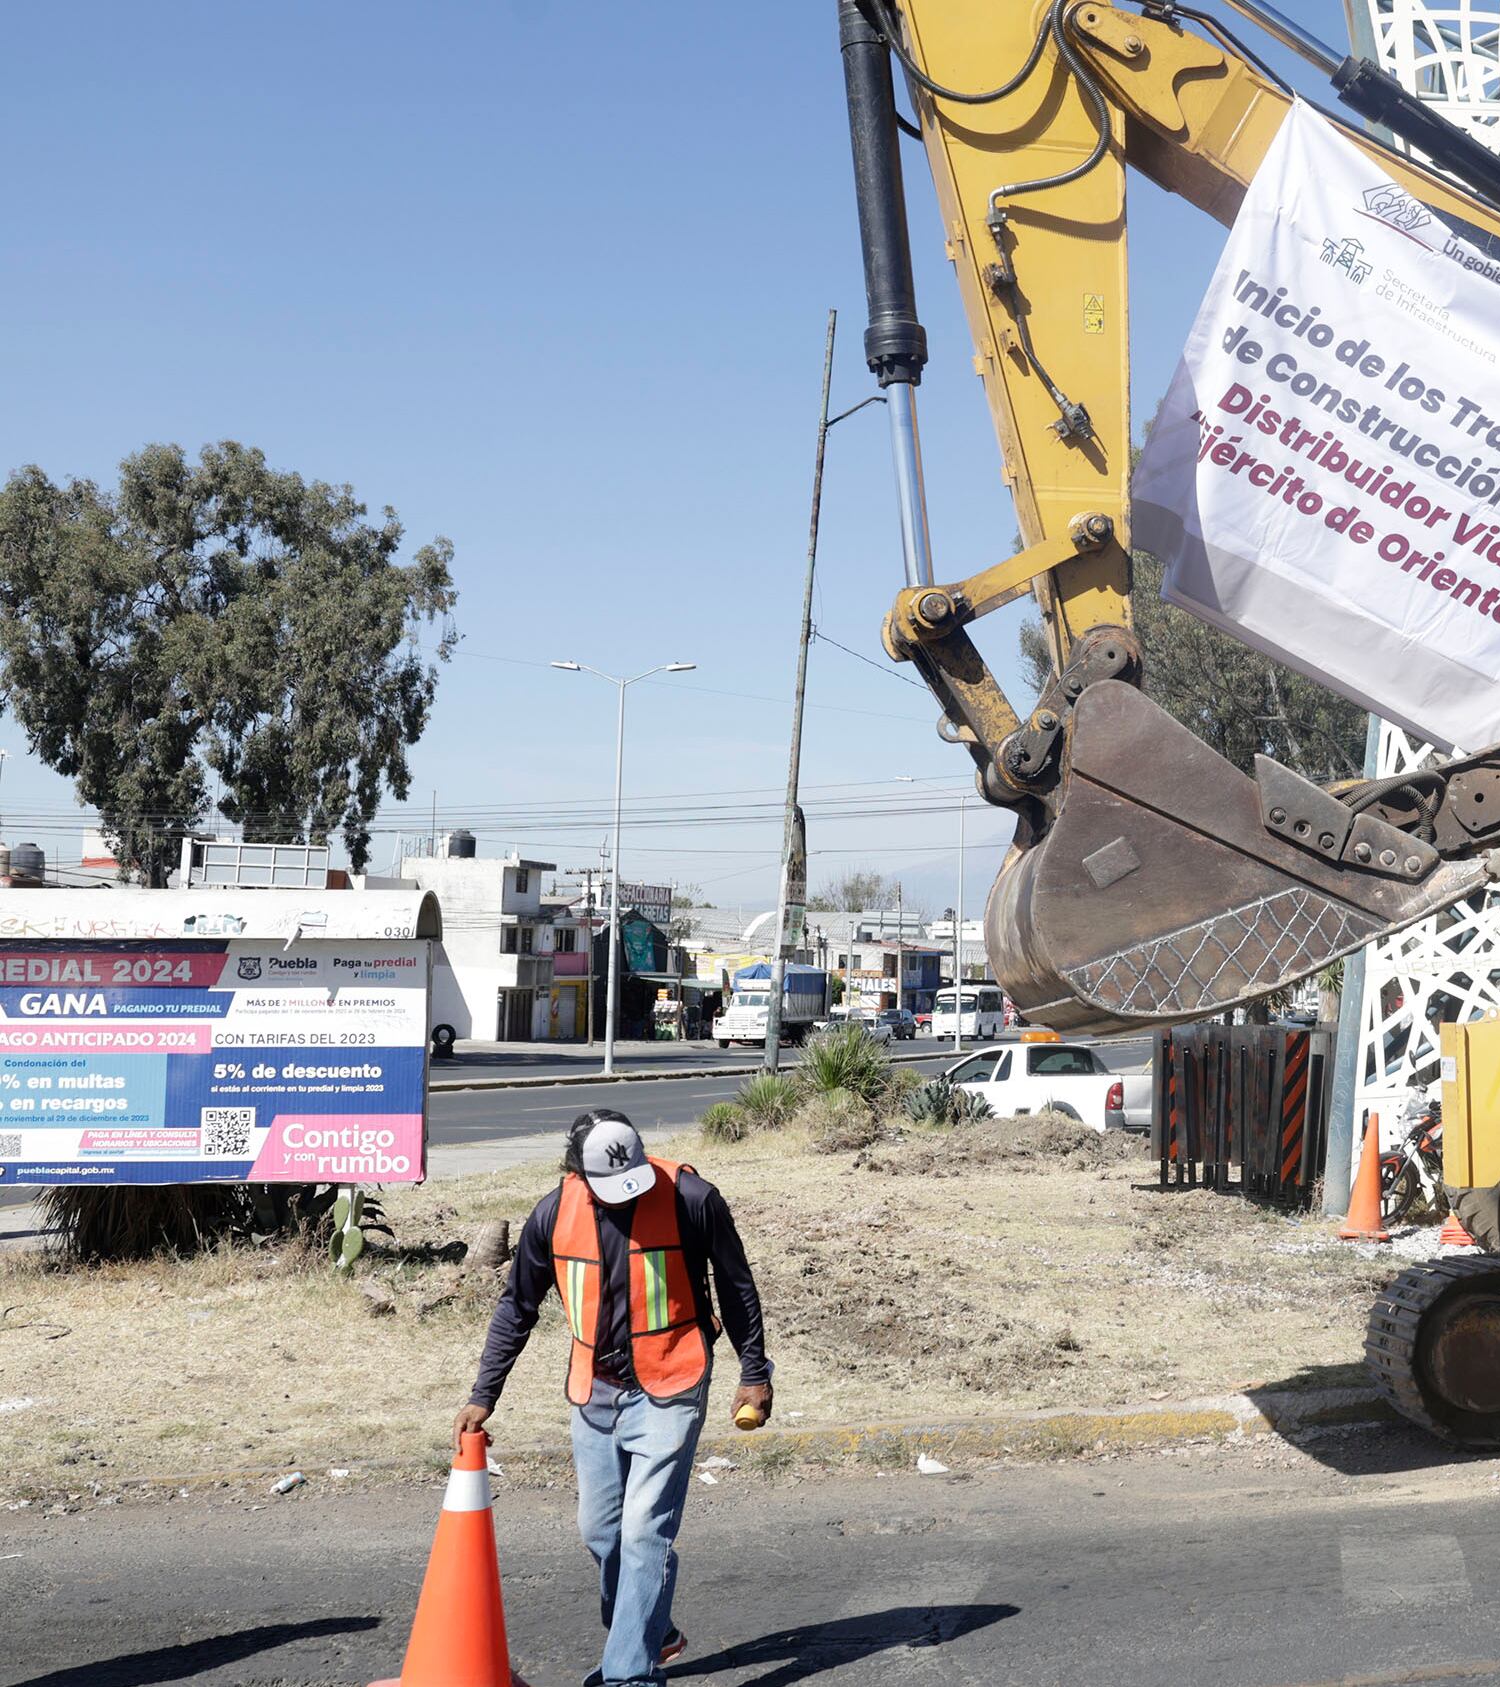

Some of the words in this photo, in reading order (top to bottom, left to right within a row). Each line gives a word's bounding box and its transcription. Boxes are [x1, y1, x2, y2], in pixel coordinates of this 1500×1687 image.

[1442, 238, 1462, 263] Un
[1375, 283, 1394, 301] de
[1396, 294, 1497, 363] Infraestructura
[1222, 325, 1263, 364] de
[1233, 269, 1334, 348] Inicio
[1335, 339, 1386, 378] de
[1384, 362, 1446, 413] los
[1217, 382, 1452, 528] Distribuidor
[1325, 506, 1374, 544] de
[0, 960, 100, 982] EDIAL
[112, 960, 193, 982] 2024
[268, 957, 318, 969] Puebla
[333, 958, 361, 969] Paga
[373, 957, 416, 969] predial
[360, 969, 396, 980] limpia
[19, 993, 107, 1015] GANA
[113, 1004, 164, 1013] PAGANDO
[165, 1004, 179, 1013] TU
[180, 1004, 222, 1013] PREDIAL
[247, 998, 266, 1007] MÁS
[268, 999, 281, 1007] DE
[282, 999, 287, 1007] 2
[338, 999, 351, 1007] EN
[353, 999, 395, 1007] PREMIOS
[40, 1032, 154, 1046] ANTICIPADO
[157, 1032, 196, 1046] 2024
[215, 1033, 244, 1045] CON
[249, 1033, 306, 1045] TARIFAS
[310, 1033, 336, 1045] DEL
[340, 1033, 376, 1045] 2023
[4, 1059, 68, 1068] Condonación
[71, 1059, 86, 1068] del
[213, 1063, 245, 1079] 5%
[252, 1063, 276, 1079] de
[282, 1063, 383, 1079] descuento
[27, 1076, 52, 1089] en
[58, 1073, 126, 1089] multas
[10, 1098, 34, 1110] en
[41, 1097, 128, 1113] recargos
[282, 1123, 395, 1155] Contigo
[284, 1153, 292, 1164] y
[294, 1153, 315, 1161] con
[317, 1150, 410, 1174] rumbo
[17, 1166, 115, 1176] pueblacapital.gob.mx
